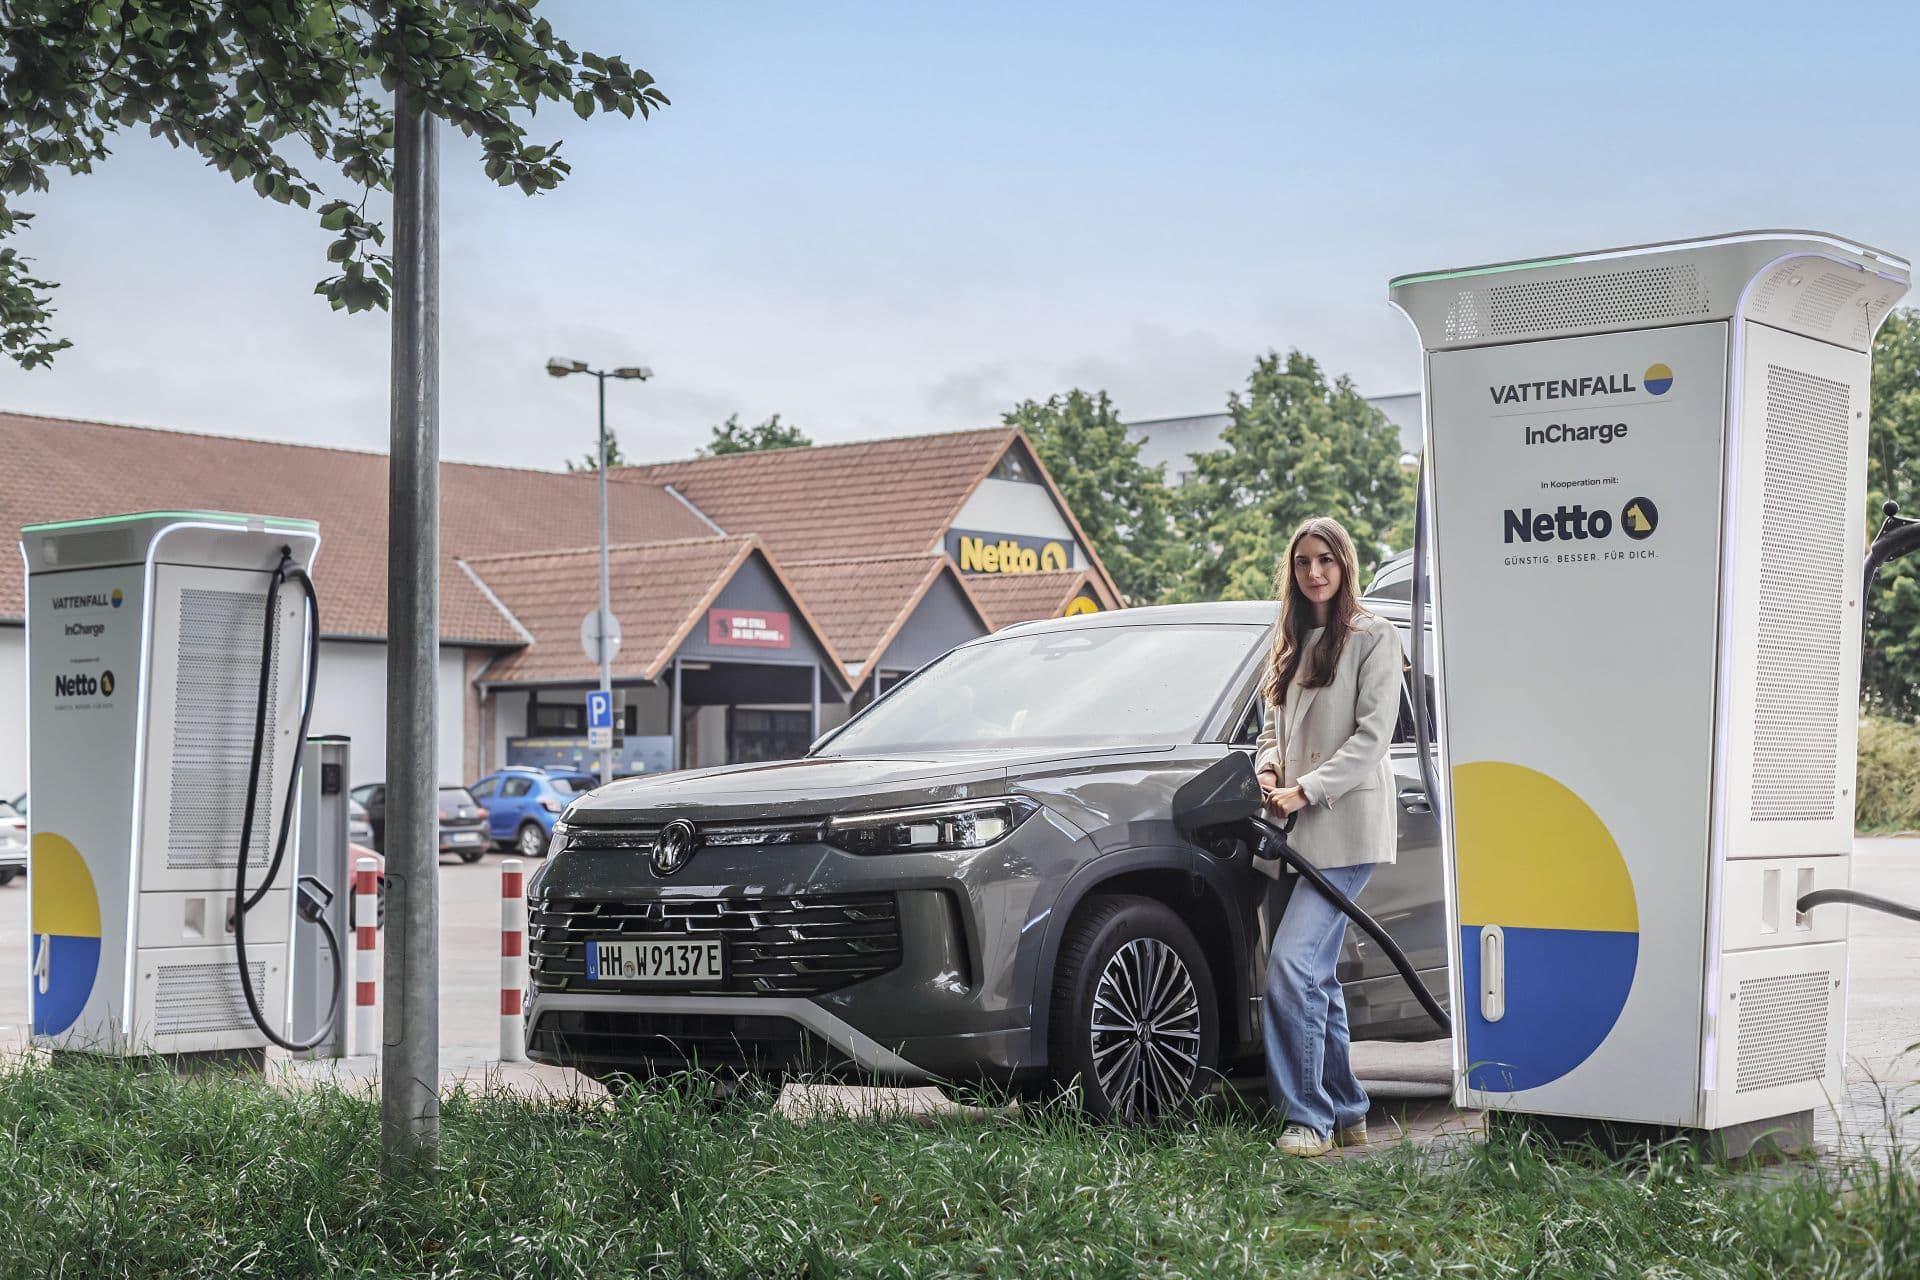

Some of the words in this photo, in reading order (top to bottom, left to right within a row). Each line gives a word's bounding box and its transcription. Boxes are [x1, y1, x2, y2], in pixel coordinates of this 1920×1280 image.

[1489, 374, 1636, 405] VATTENFALL
[1525, 423, 1628, 445] InCharge
[1541, 481, 1549, 489] In
[1550, 478, 1601, 489] Kooperation
[1602, 476, 1619, 486] mit:
[1503, 504, 1613, 544] Netto
[960, 536, 1038, 574] Netto
[1504, 555, 1553, 566] GÜNSTIG.
[1557, 553, 1600, 563] BESSER.
[1604, 550, 1625, 561] FÜR
[1629, 550, 1660, 560] DICH.
[52, 594, 109, 610] VATTENFALL
[64, 623, 105, 637] InCharge
[55, 674, 97, 697] Netto
[591, 695, 607, 726] P
[599, 946, 623, 976] HH
